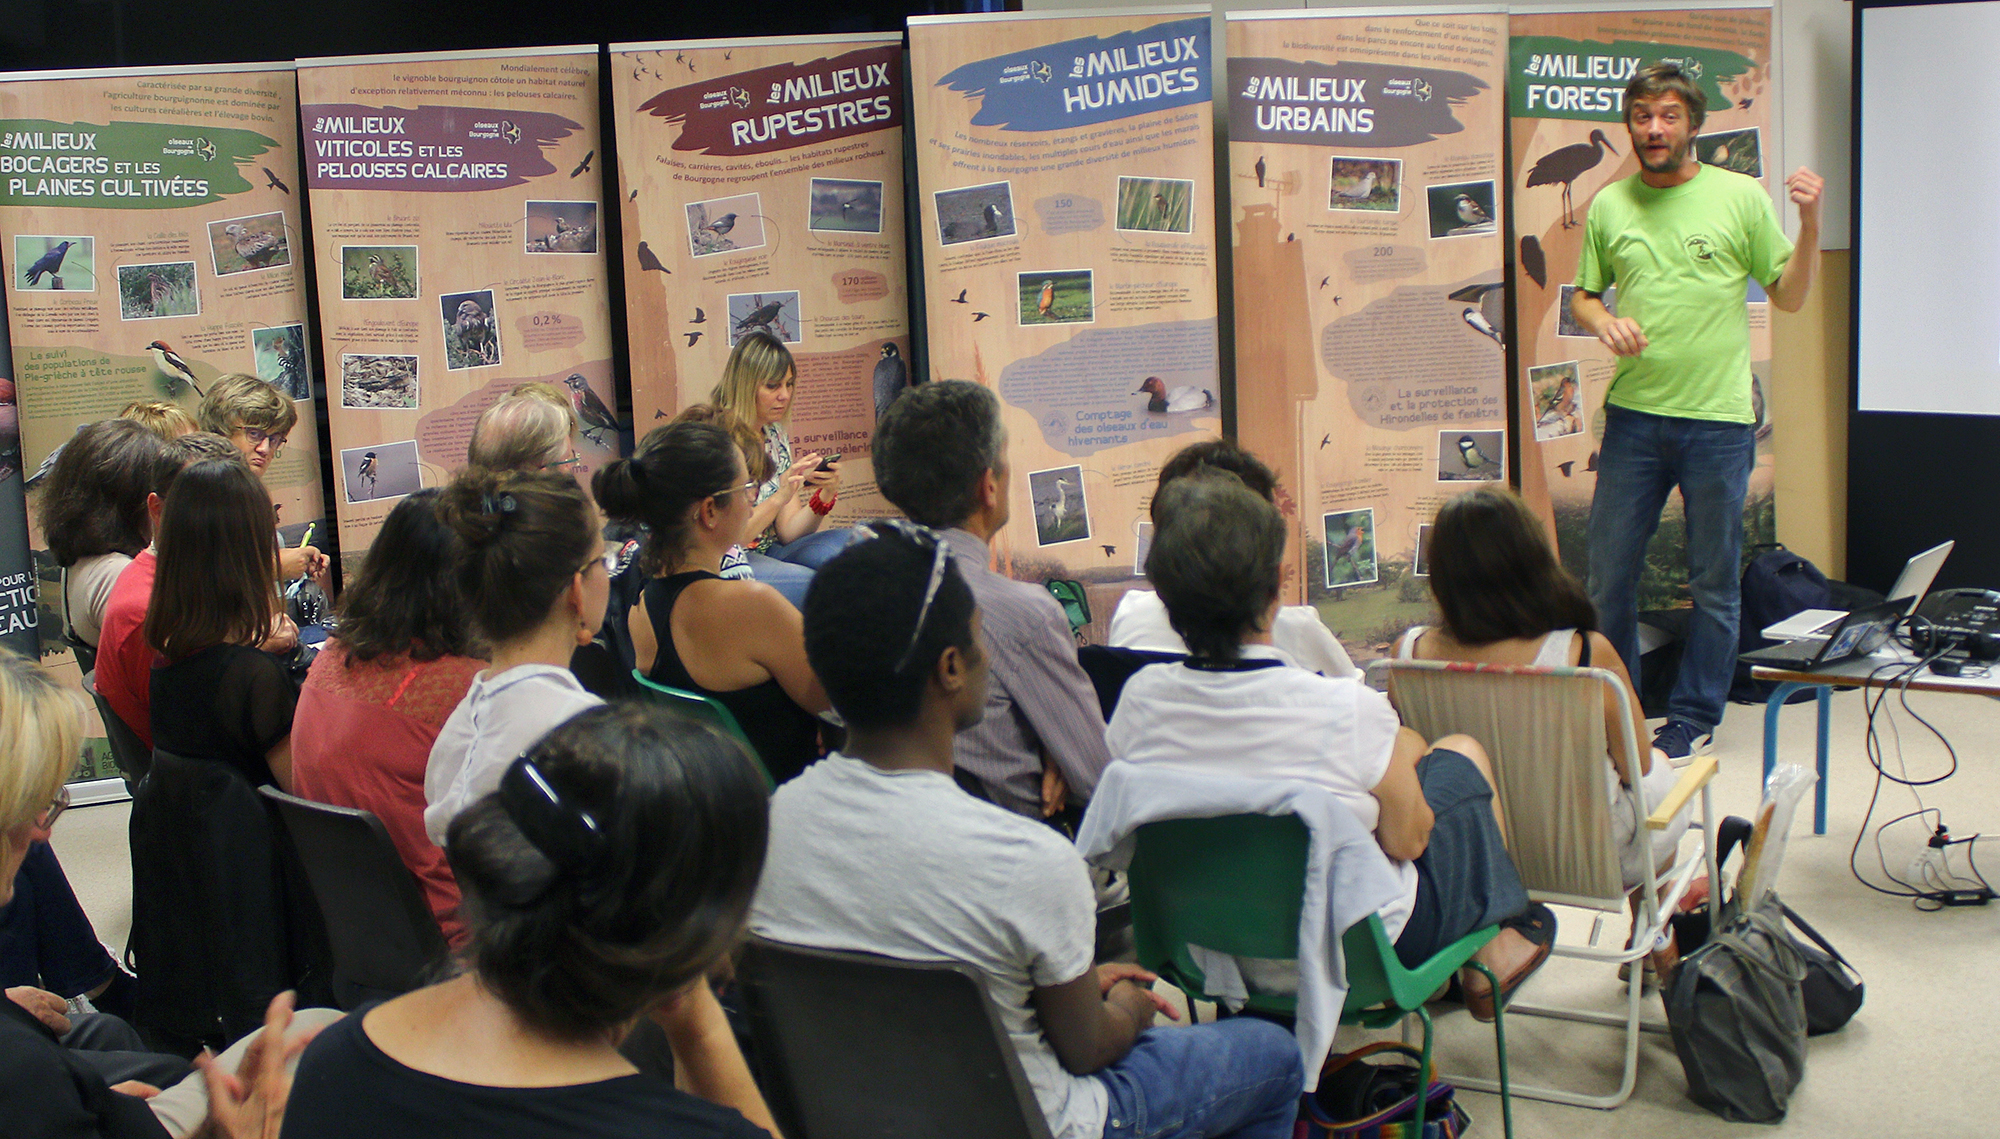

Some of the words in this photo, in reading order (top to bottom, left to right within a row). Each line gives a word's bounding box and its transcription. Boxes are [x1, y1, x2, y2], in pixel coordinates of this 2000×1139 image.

[1292, 42, 1334, 51] biodiversité
[1069, 56, 1084, 78] les
[1087, 36, 1199, 77] MILIEUX
[501, 65, 558, 73] Mondialement
[1524, 54, 1542, 75] les
[1540, 54, 1641, 80] MILIEUX
[403, 75, 436, 83] vignoble
[438, 75, 488, 84] bourguignon
[529, 77, 555, 85] habitat
[767, 83, 781, 104] les
[784, 62, 890, 103] MILIEUX
[137, 81, 186, 90] Caractérisée
[189, 84, 202, 93] par
[215, 85, 242, 95] grande
[350, 87, 396, 96] d'exception
[398, 88, 448, 96] relativement
[506, 90, 540, 100] pelouses
[1064, 67, 1199, 113] HUMIDES
[1242, 77, 1260, 98] les
[1259, 76, 1367, 103] MILIEUX
[154, 95, 215, 106] bourguignonne
[231, 100, 265, 108] dominée
[159, 107, 202, 116] céréalières
[1257, 106, 1374, 132] URBAINS
[313, 118, 325, 132] les
[324, 117, 405, 134] MILIEUX
[731, 96, 891, 146] RUPESTRES
[955, 131, 968, 139] Les
[970, 136, 1007, 147] nombreux
[1053, 134, 1078, 146] étangs
[1080, 132, 1088, 140] et
[1138, 119, 1161, 132] plaine
[0, 133, 13, 149] les
[13, 133, 96, 151] MILIEUX
[315, 140, 413, 157] VITICOLES
[419, 146, 435, 157] ET
[438, 146, 463, 157] LES
[939, 141, 950, 150] ses
[952, 145, 980, 158] prairies
[1030, 153, 1040, 161] les
[1042, 147, 1078, 160] multiples
[1080, 144, 1097, 152] cours
[1126, 136, 1143, 144] ainsi
[1145, 133, 1160, 143] que
[1175, 123, 1200, 134] marais
[802, 150, 832, 160] habitats
[834, 141, 869, 154] rupestres
[0, 156, 108, 174] BOCAGERS
[115, 163, 132, 174] ET
[135, 163, 160, 174] LES
[953, 160, 979, 171] offrent
[981, 164, 986, 172] à
[988, 164, 994, 172] la
[997, 164, 1038, 174] Bourgogne
[1058, 159, 1084, 171] grande
[1086, 152, 1119, 164] diversité
[1133, 143, 1160, 155] milieux
[318, 163, 406, 178] PELOUSES
[411, 163, 507, 179] CALCAIRES
[673, 173, 682, 181] de
[684, 174, 724, 184] Bourgogne
[727, 172, 768, 183] regroupent
[827, 156, 853, 167] milieux
[10, 179, 94, 196] PLAINES
[101, 175, 208, 197] CULTIVÉES
[1055, 199, 1072, 208] 150
[1374, 247, 1393, 256] 200
[842, 277, 859, 286] 170
[551, 315, 561, 324] %
[30, 351, 44, 360] Le
[46, 350, 67, 359] suivi
[43, 358, 96, 371] populations
[100, 357, 110, 365] de
[25, 370, 77, 382] Pie-grièche
[90, 367, 111, 377] tête
[115, 365, 146, 374] rousse
[1398, 389, 1412, 398] La
[1482, 396, 1498, 404] des
[1076, 409, 1132, 423] Comptage
[1442, 411, 1454, 419] de
[1075, 425, 1093, 433] des
[1097, 422, 1136, 432] oiseaux
[1068, 434, 1128, 446] hivernants
